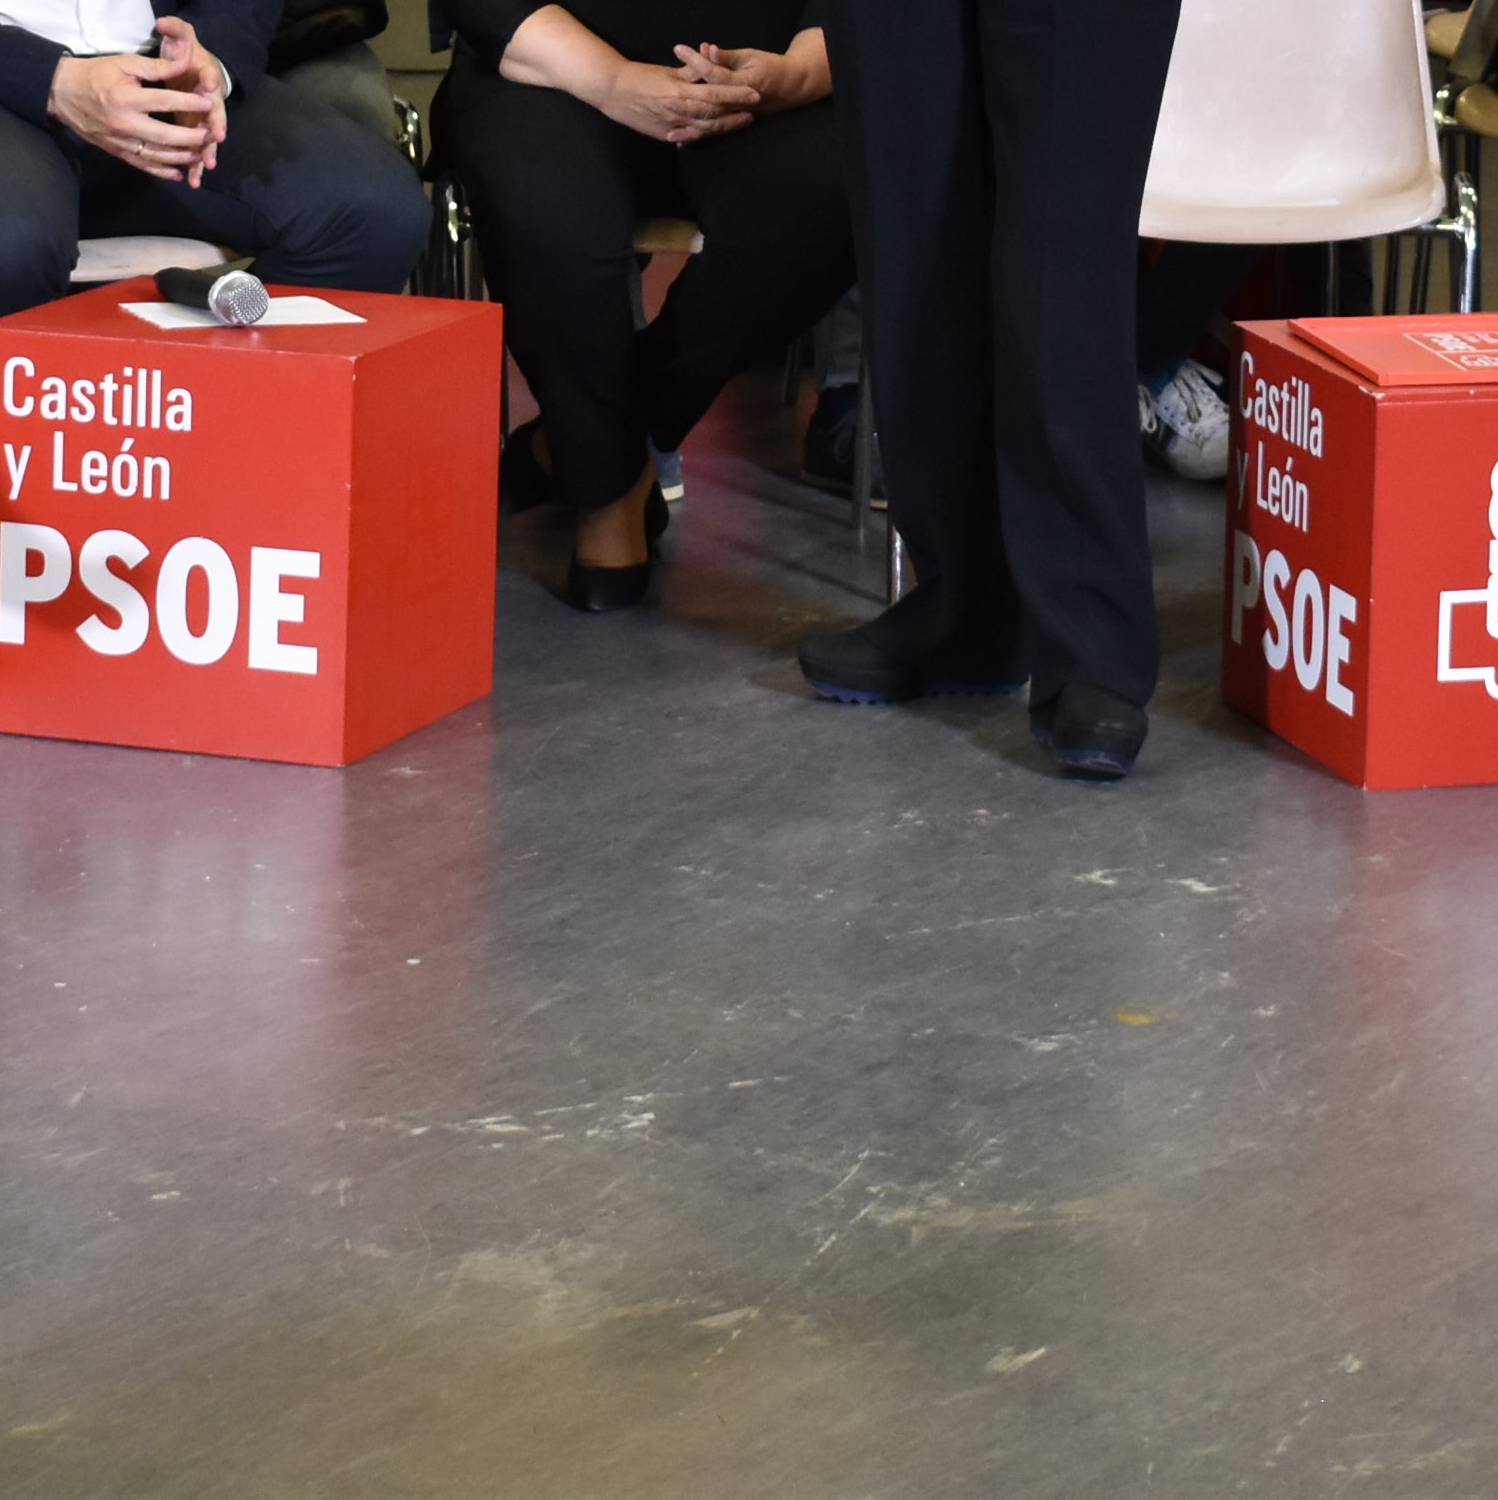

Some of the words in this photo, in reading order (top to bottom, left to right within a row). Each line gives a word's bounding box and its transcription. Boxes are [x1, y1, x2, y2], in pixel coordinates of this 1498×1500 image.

[3, 356, 193, 432] Castilla
[1239, 350, 1323, 458] Castilla
[3, 443, 32, 501] y
[52, 430, 172, 501] León
[1236, 448, 1249, 510] y
[1256, 440, 1307, 532] León
[1231, 529, 1357, 717] PSOE
